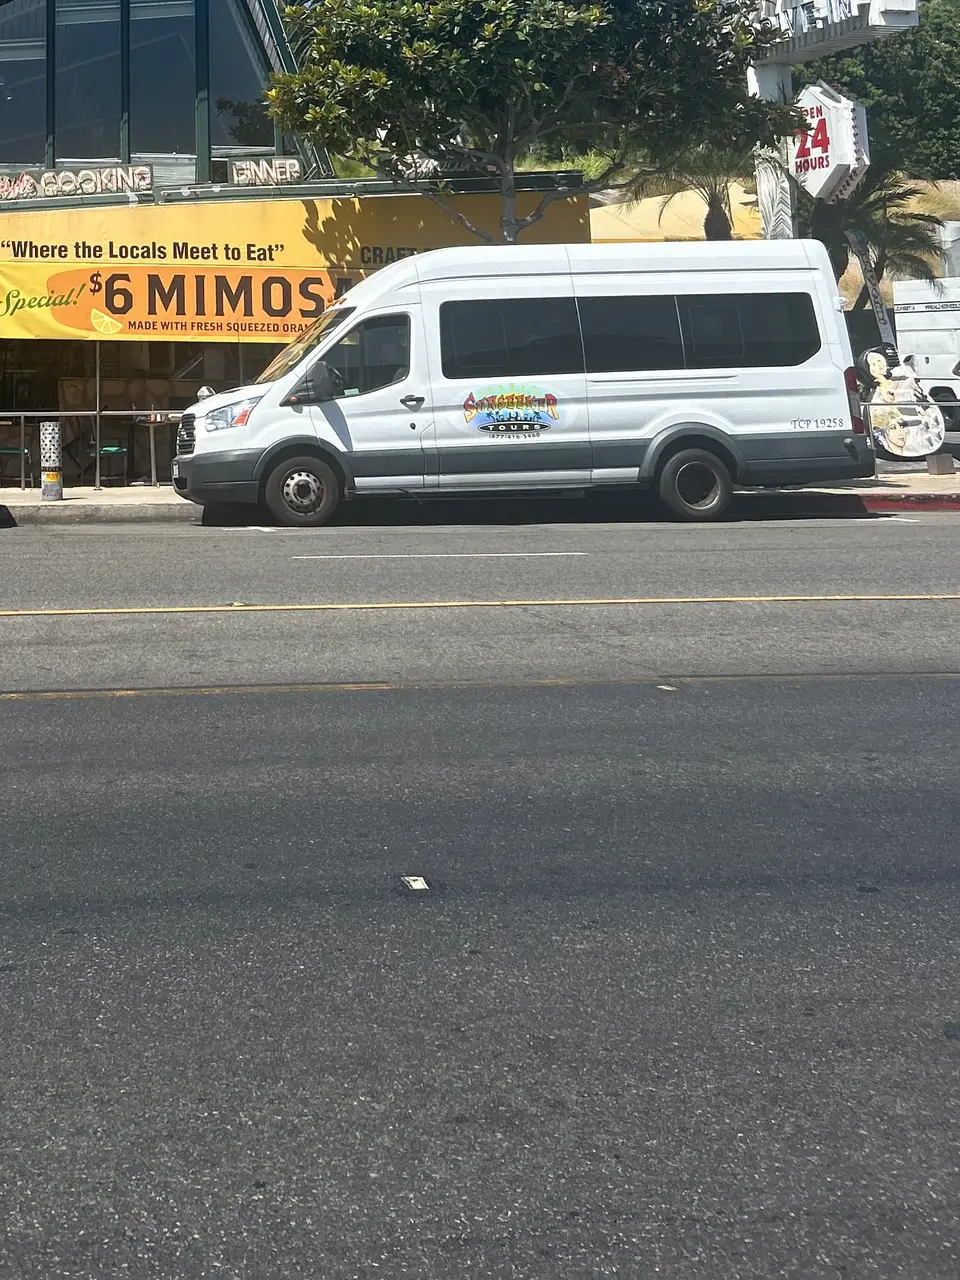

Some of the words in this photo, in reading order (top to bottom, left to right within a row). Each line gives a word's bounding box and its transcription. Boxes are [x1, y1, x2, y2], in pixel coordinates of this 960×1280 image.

[801, 105, 823, 119] PEN
[793, 118, 830, 159] 24
[232, 159, 302, 186] DINNER
[794, 154, 830, 173] HOURS
[41, 166, 151, 197] COOKING
[0, 240, 68, 258] “Where
[74, 241, 103, 258] the
[109, 241, 167, 259] Locals
[172, 243, 219, 260] Meet
[224, 244, 241, 261] to
[246, 244, 285, 262] Eat”
[89, 270, 133, 315] $6
[128, 320, 158, 330] MADE
[160, 321, 187, 331] WITH
[190, 321, 223, 331] FRESH
[226, 322, 280, 333] SQUEEZED
[463, 391, 559, 423] SUNSEEKER
[790, 417, 811, 429] TCP
[814, 417, 844, 428] 19258
